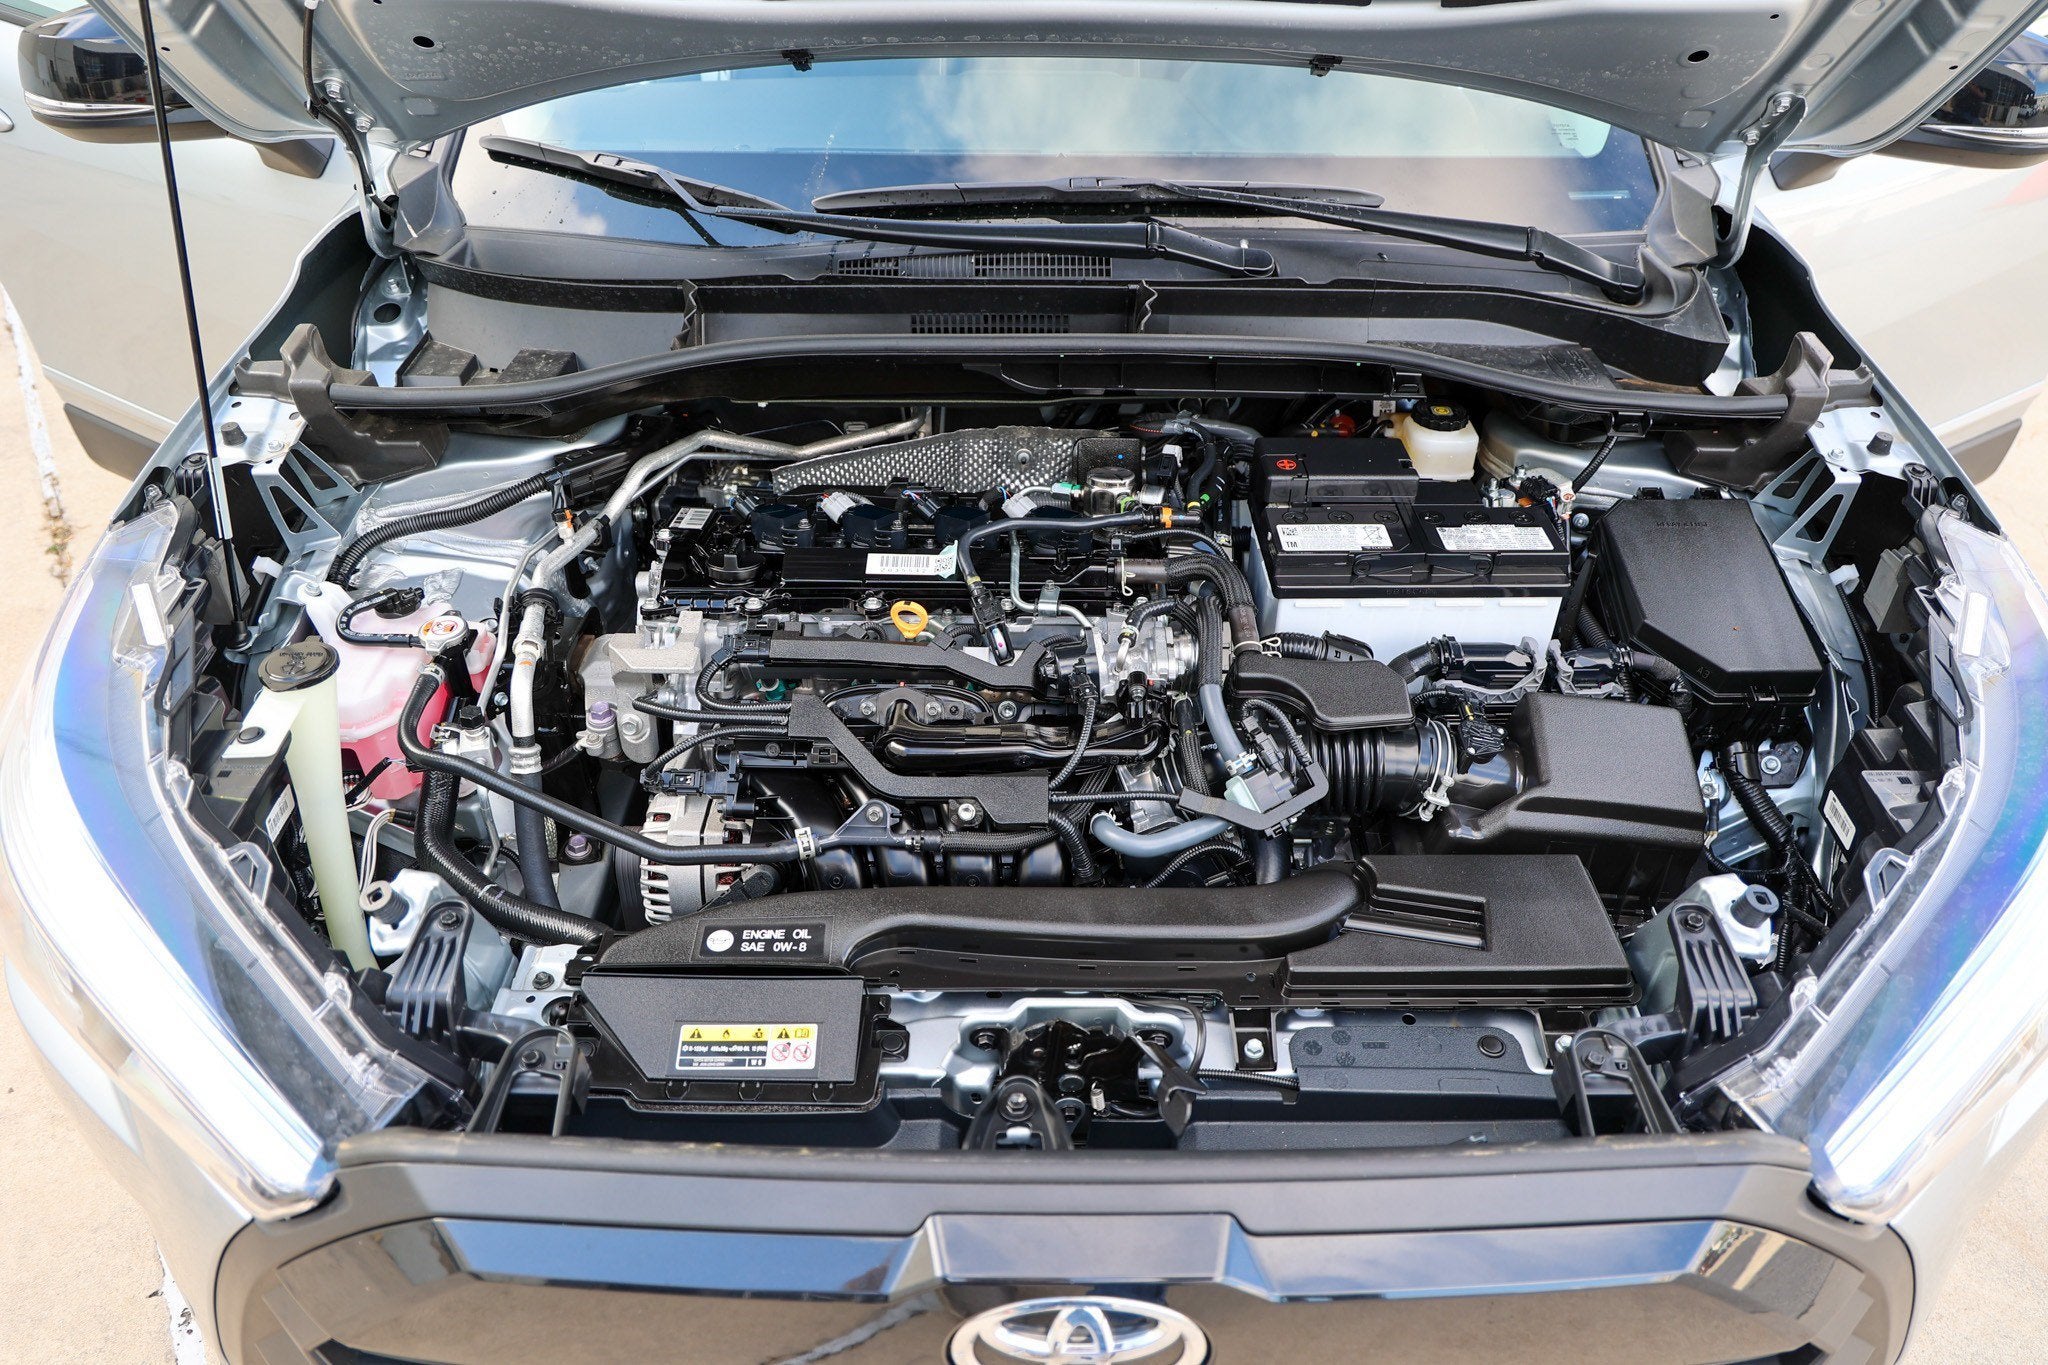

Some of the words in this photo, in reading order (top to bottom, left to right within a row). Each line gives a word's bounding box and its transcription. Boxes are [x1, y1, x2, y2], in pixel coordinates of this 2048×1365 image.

[742, 929, 786, 940] ENGINE
[792, 928, 812, 940] OIL
[740, 941, 766, 952] SAE
[772, 941, 807, 953] 0W-8
